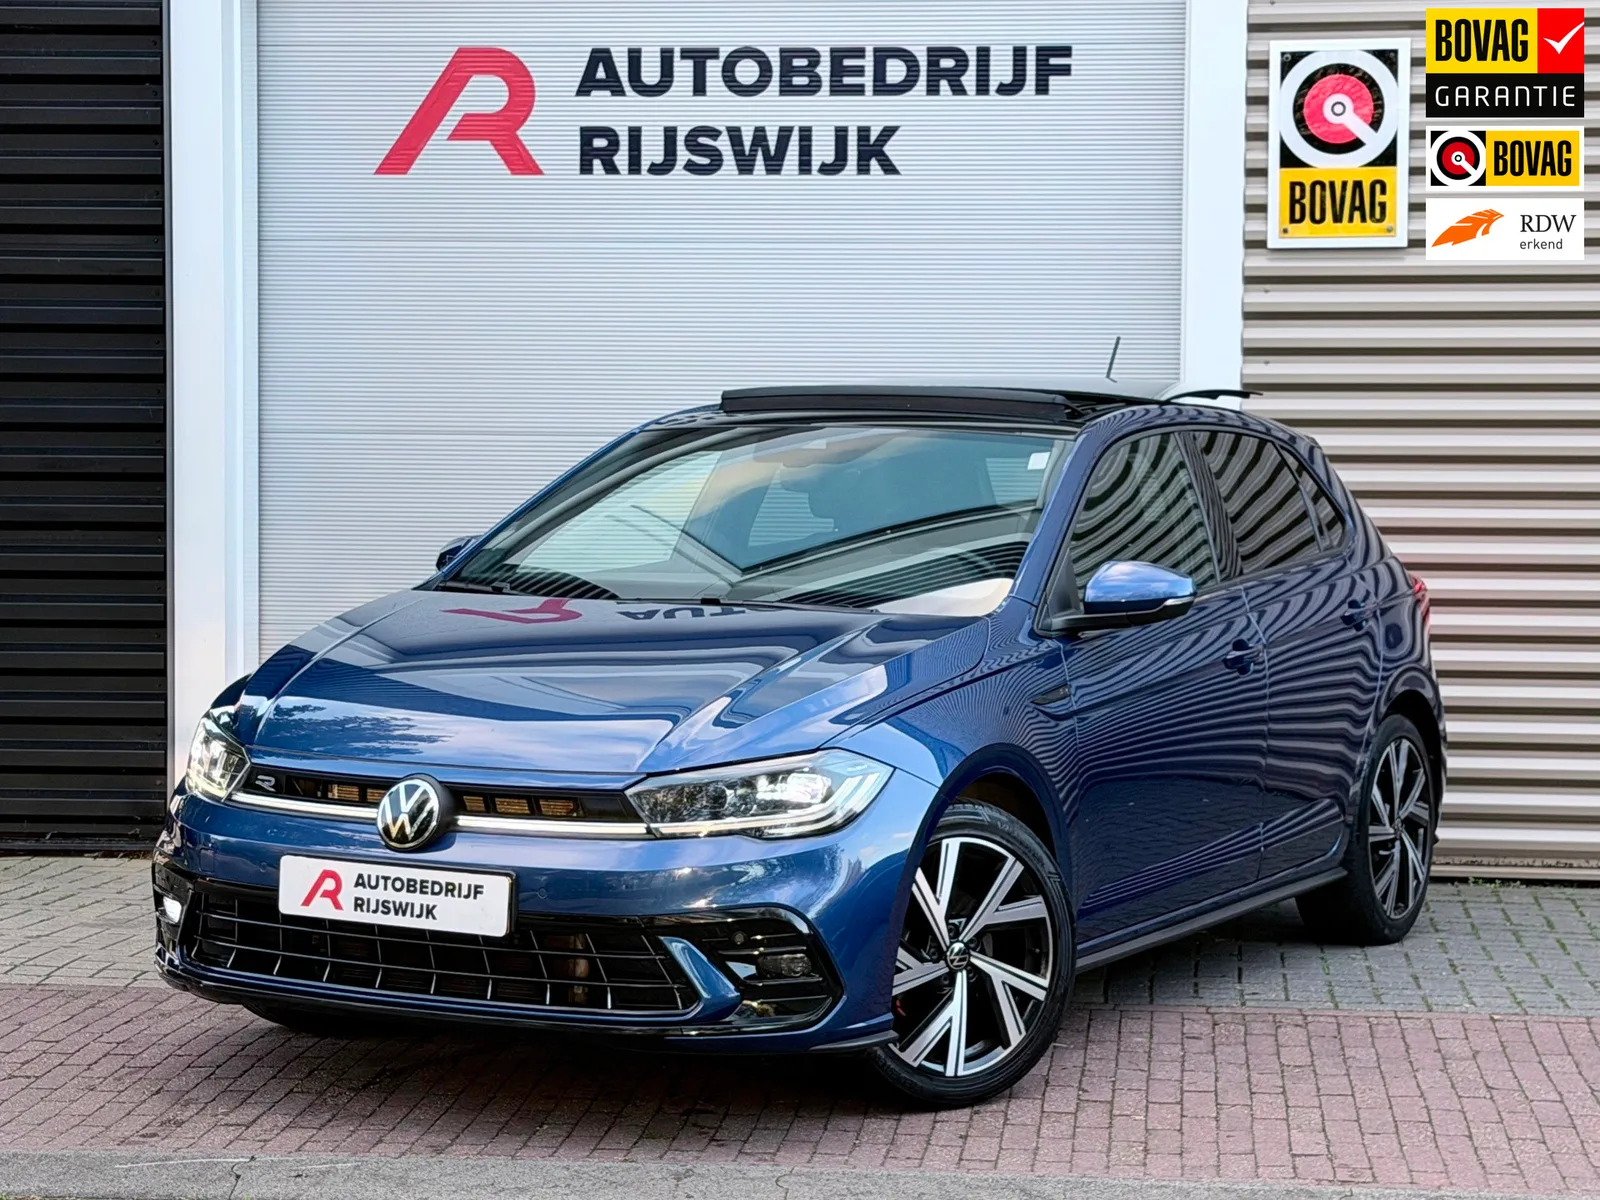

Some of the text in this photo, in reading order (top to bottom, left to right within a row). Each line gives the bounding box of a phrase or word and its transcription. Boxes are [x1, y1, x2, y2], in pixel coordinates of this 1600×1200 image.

[575, 45, 1073, 97] AUTOBEDRIJF
[579, 125, 902, 176] RIJSWIJK
[1289, 179, 1387, 224] BOVAG
[353, 873, 484, 900] AUTOBEDRIJF
[353, 897, 438, 920] RIJSWIJK
